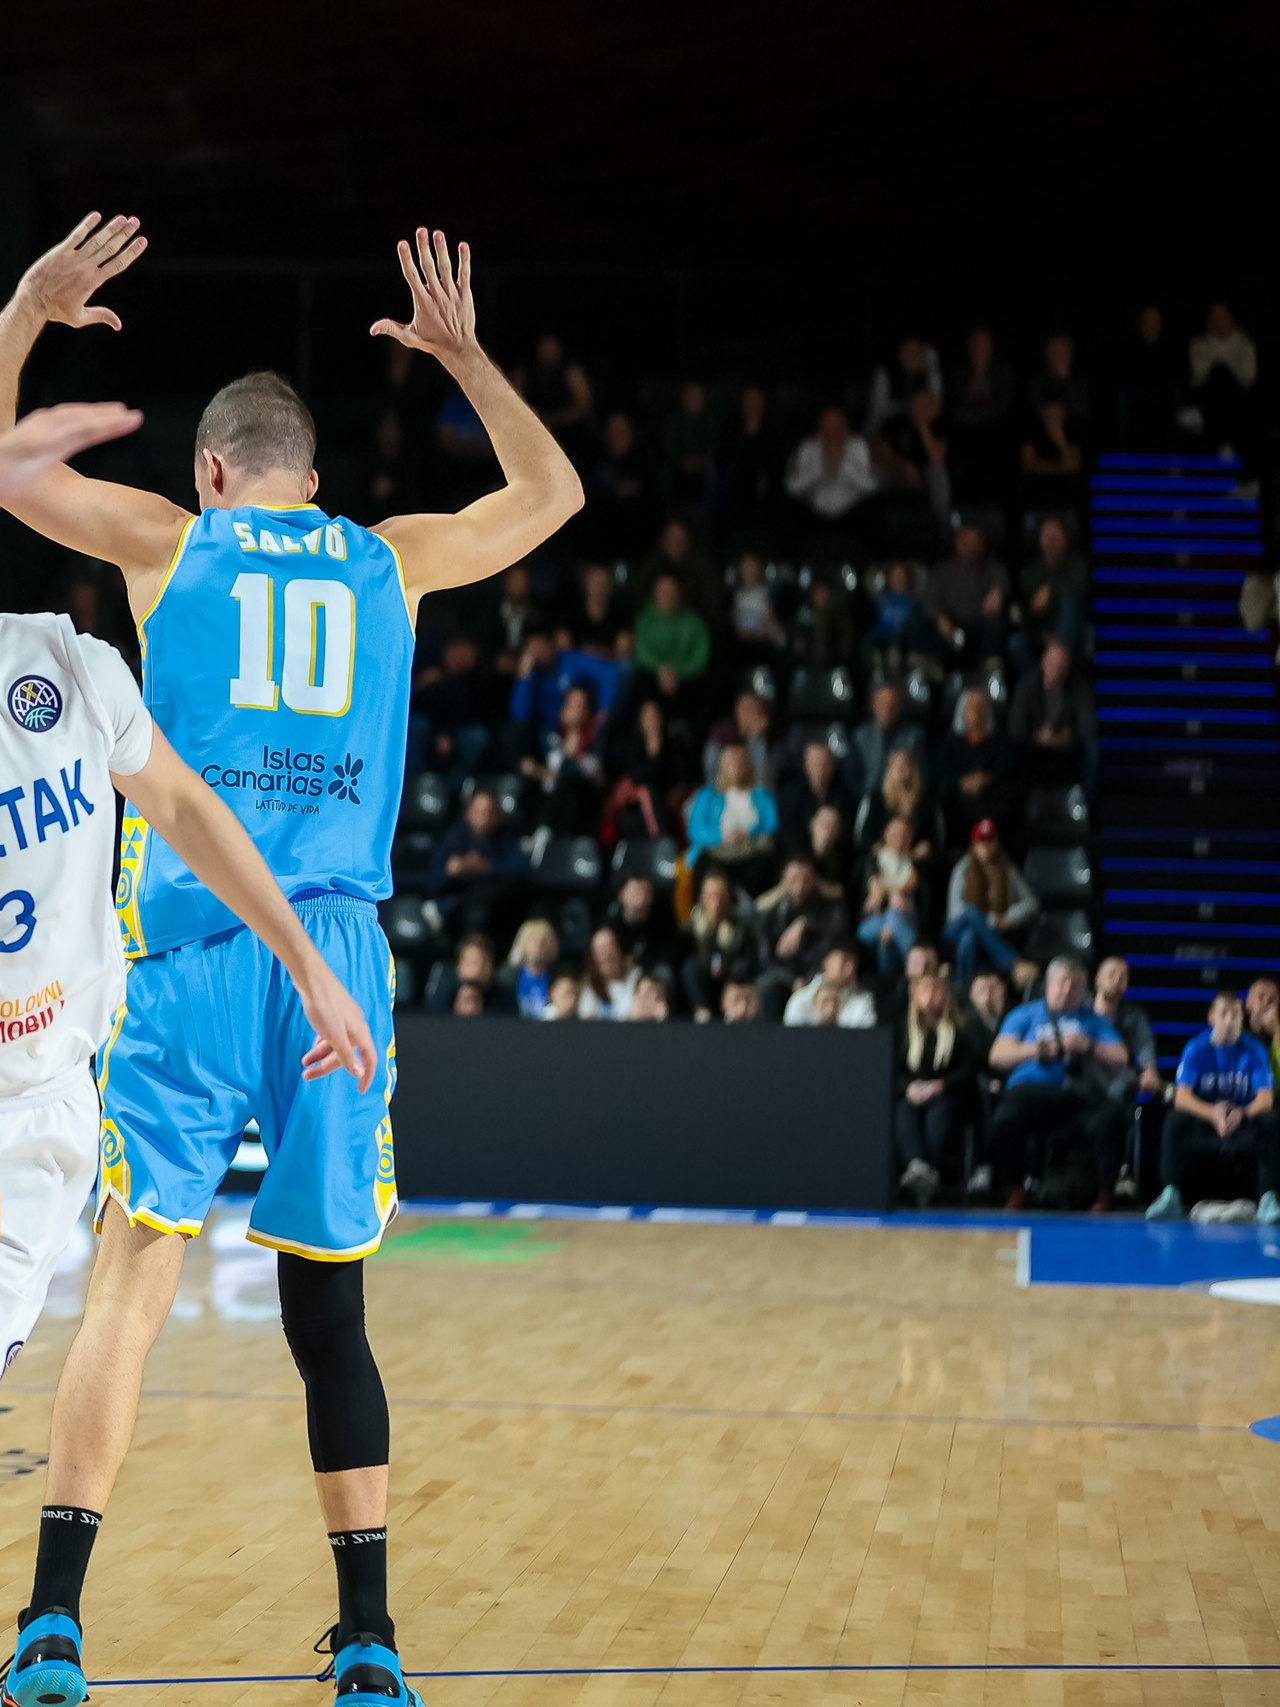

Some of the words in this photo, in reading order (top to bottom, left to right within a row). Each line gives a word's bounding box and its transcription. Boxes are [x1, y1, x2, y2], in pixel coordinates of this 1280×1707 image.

[229, 572, 357, 717] 10
[263, 745, 326, 774] Islas
[201, 763, 324, 797] Canarias
[255, 798, 286, 813] LATITUD
[287, 803, 299, 814] DE
[299, 804, 321, 815] VIDA
